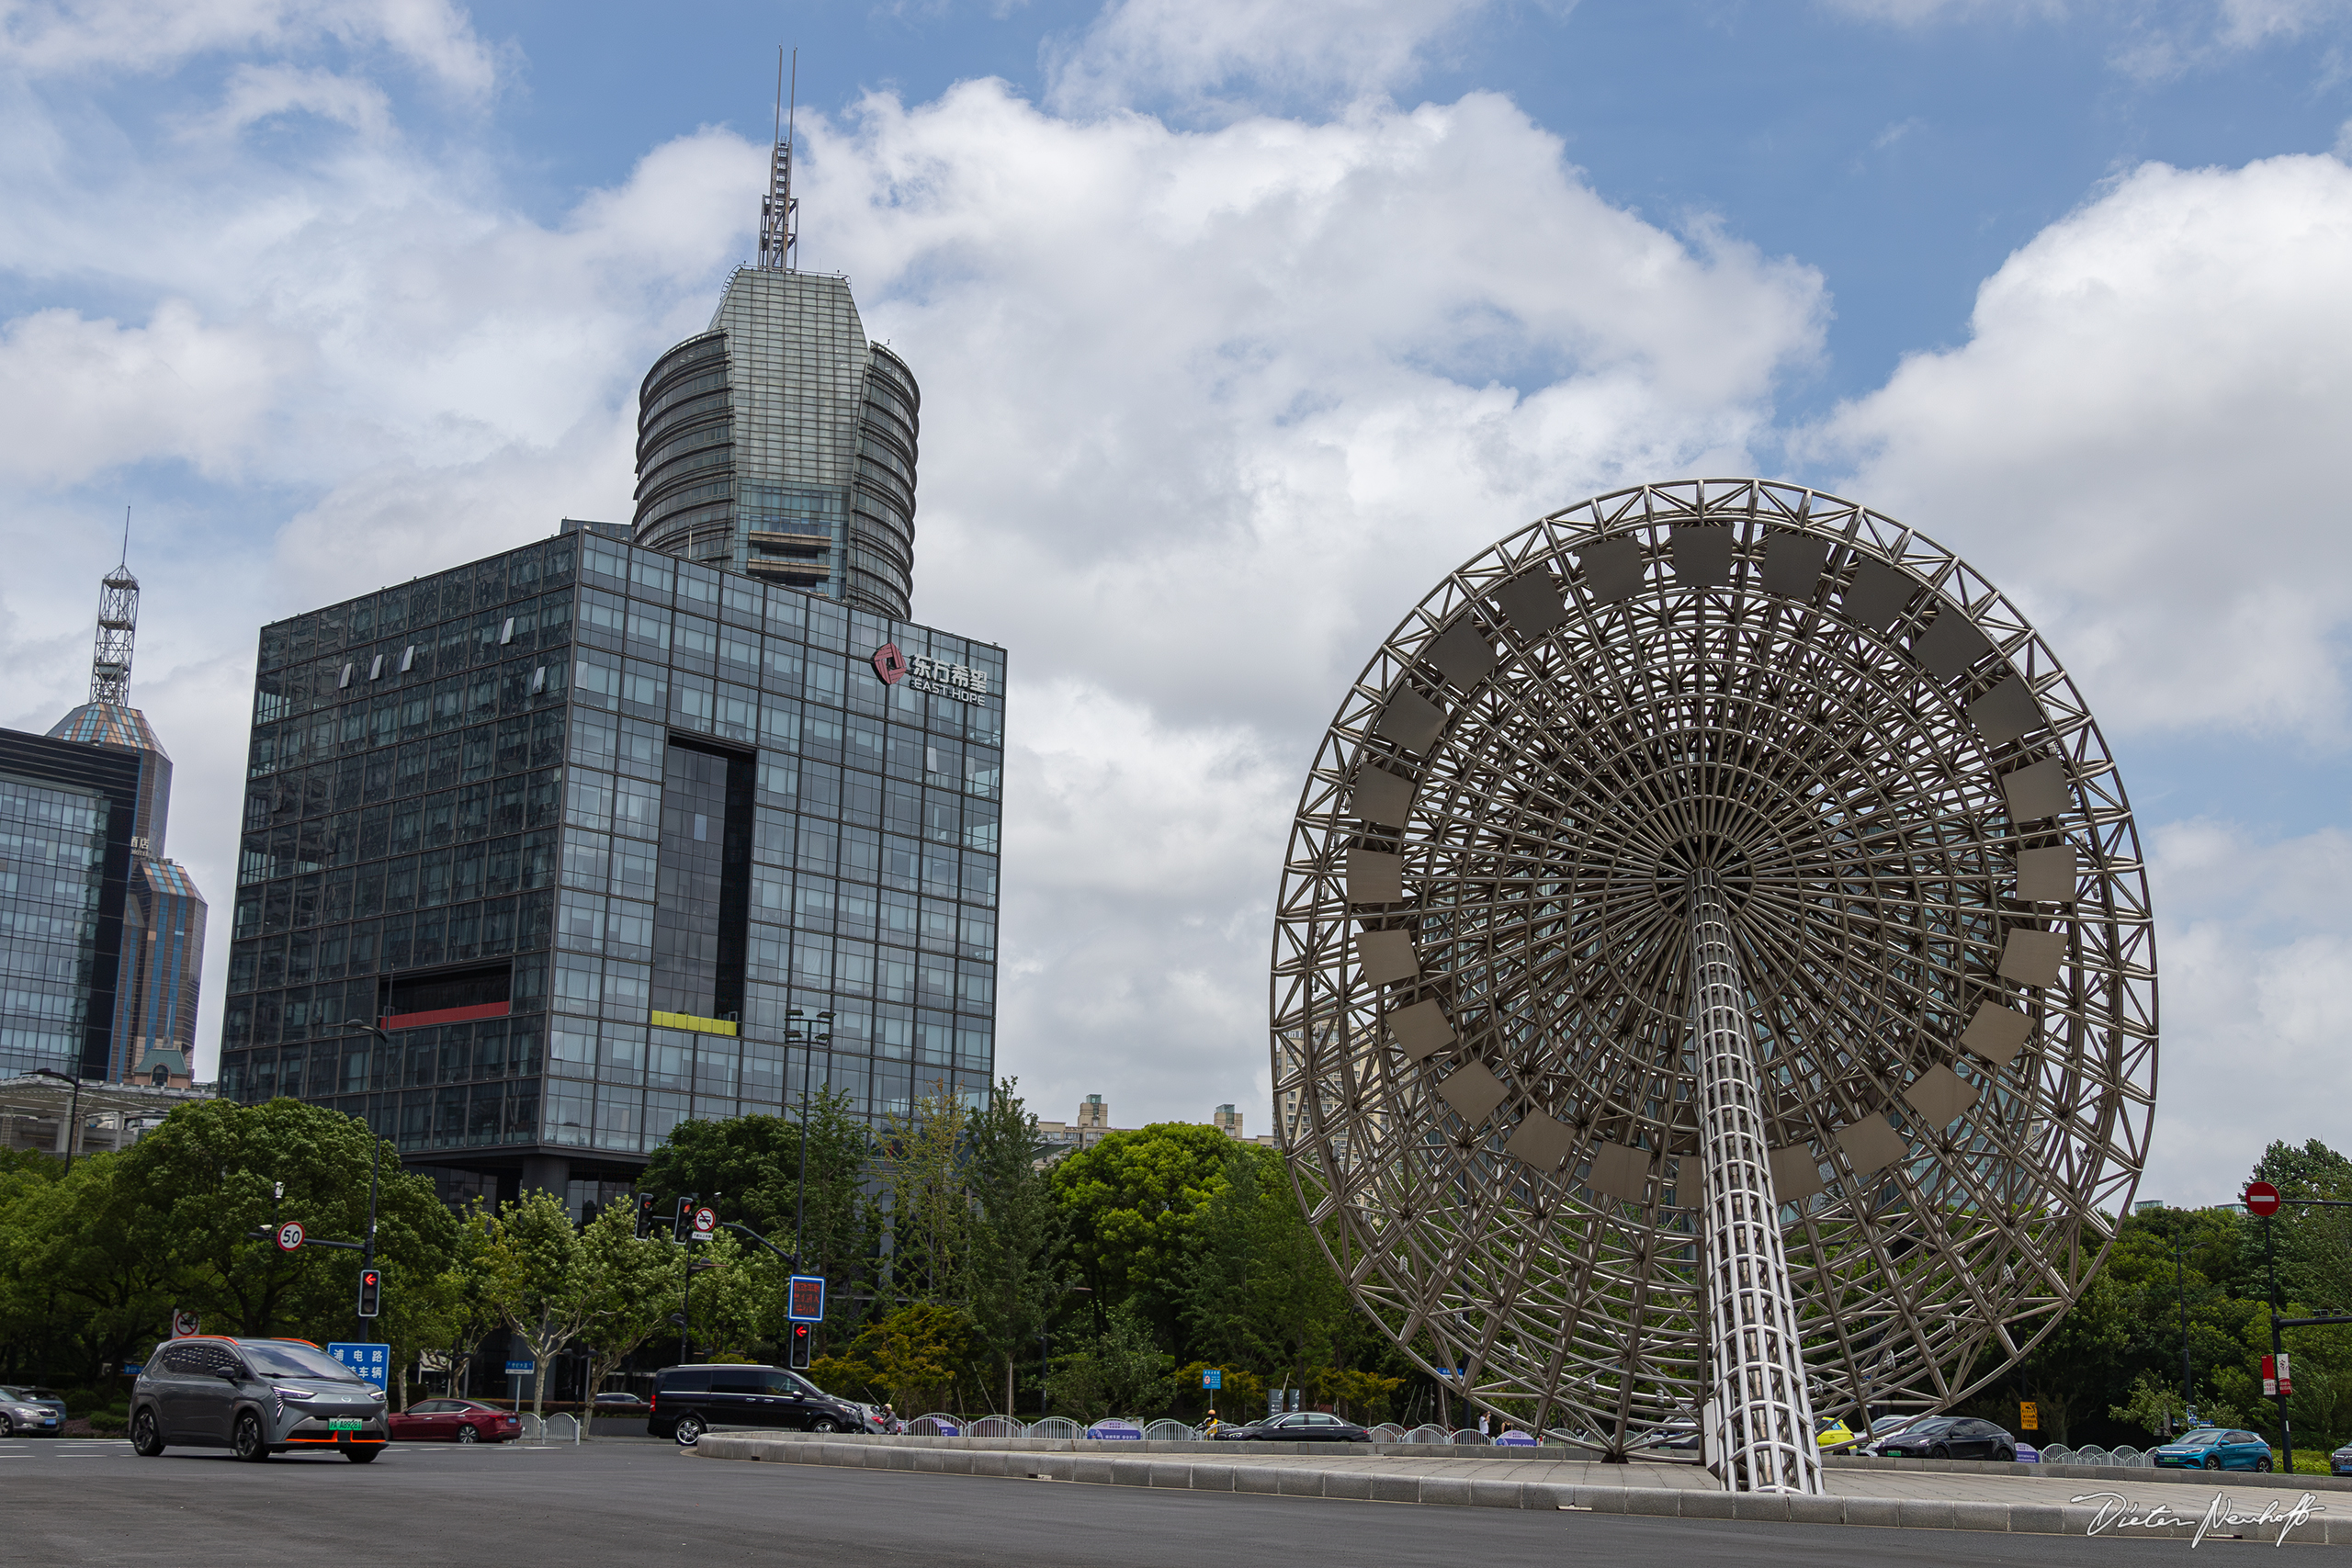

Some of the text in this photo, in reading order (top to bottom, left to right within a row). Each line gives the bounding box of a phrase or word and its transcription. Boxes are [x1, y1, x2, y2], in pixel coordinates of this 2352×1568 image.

[914, 653, 988, 694] 东方希望
[914, 679, 985, 706] EAST HOPE
[282, 1229, 300, 1244] 50
[334, 1348, 383, 1362] 浦电路
